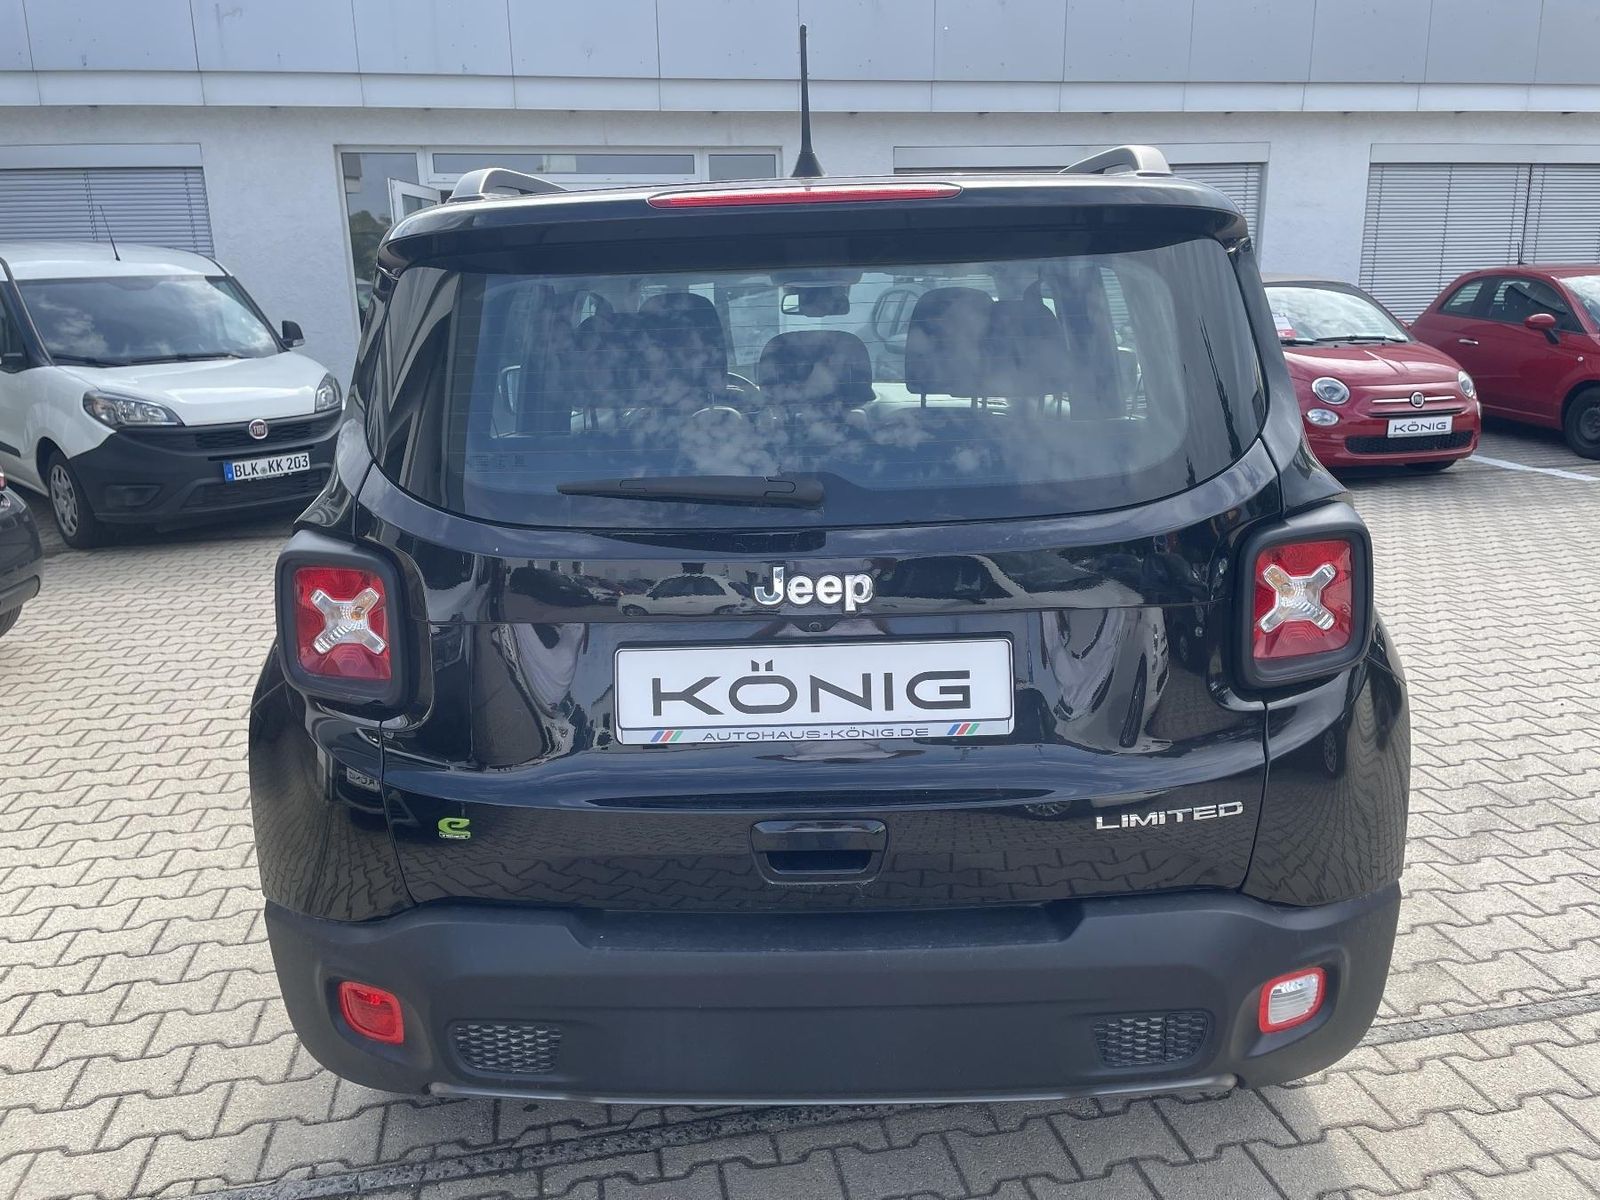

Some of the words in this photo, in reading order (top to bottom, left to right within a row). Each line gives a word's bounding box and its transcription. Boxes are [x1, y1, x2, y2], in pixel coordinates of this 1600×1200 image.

[1393, 420, 1447, 433] KÖNIG
[233, 461, 259, 478] BLK
[267, 458, 284, 474] KK
[286, 455, 309, 470] 203
[753, 565, 874, 612] Jeep
[651, 658, 972, 717] KÖNIG
[702, 726, 930, 743] AUTOHAUS-KÖNIG.DE
[1095, 801, 1245, 830] LIMITED
